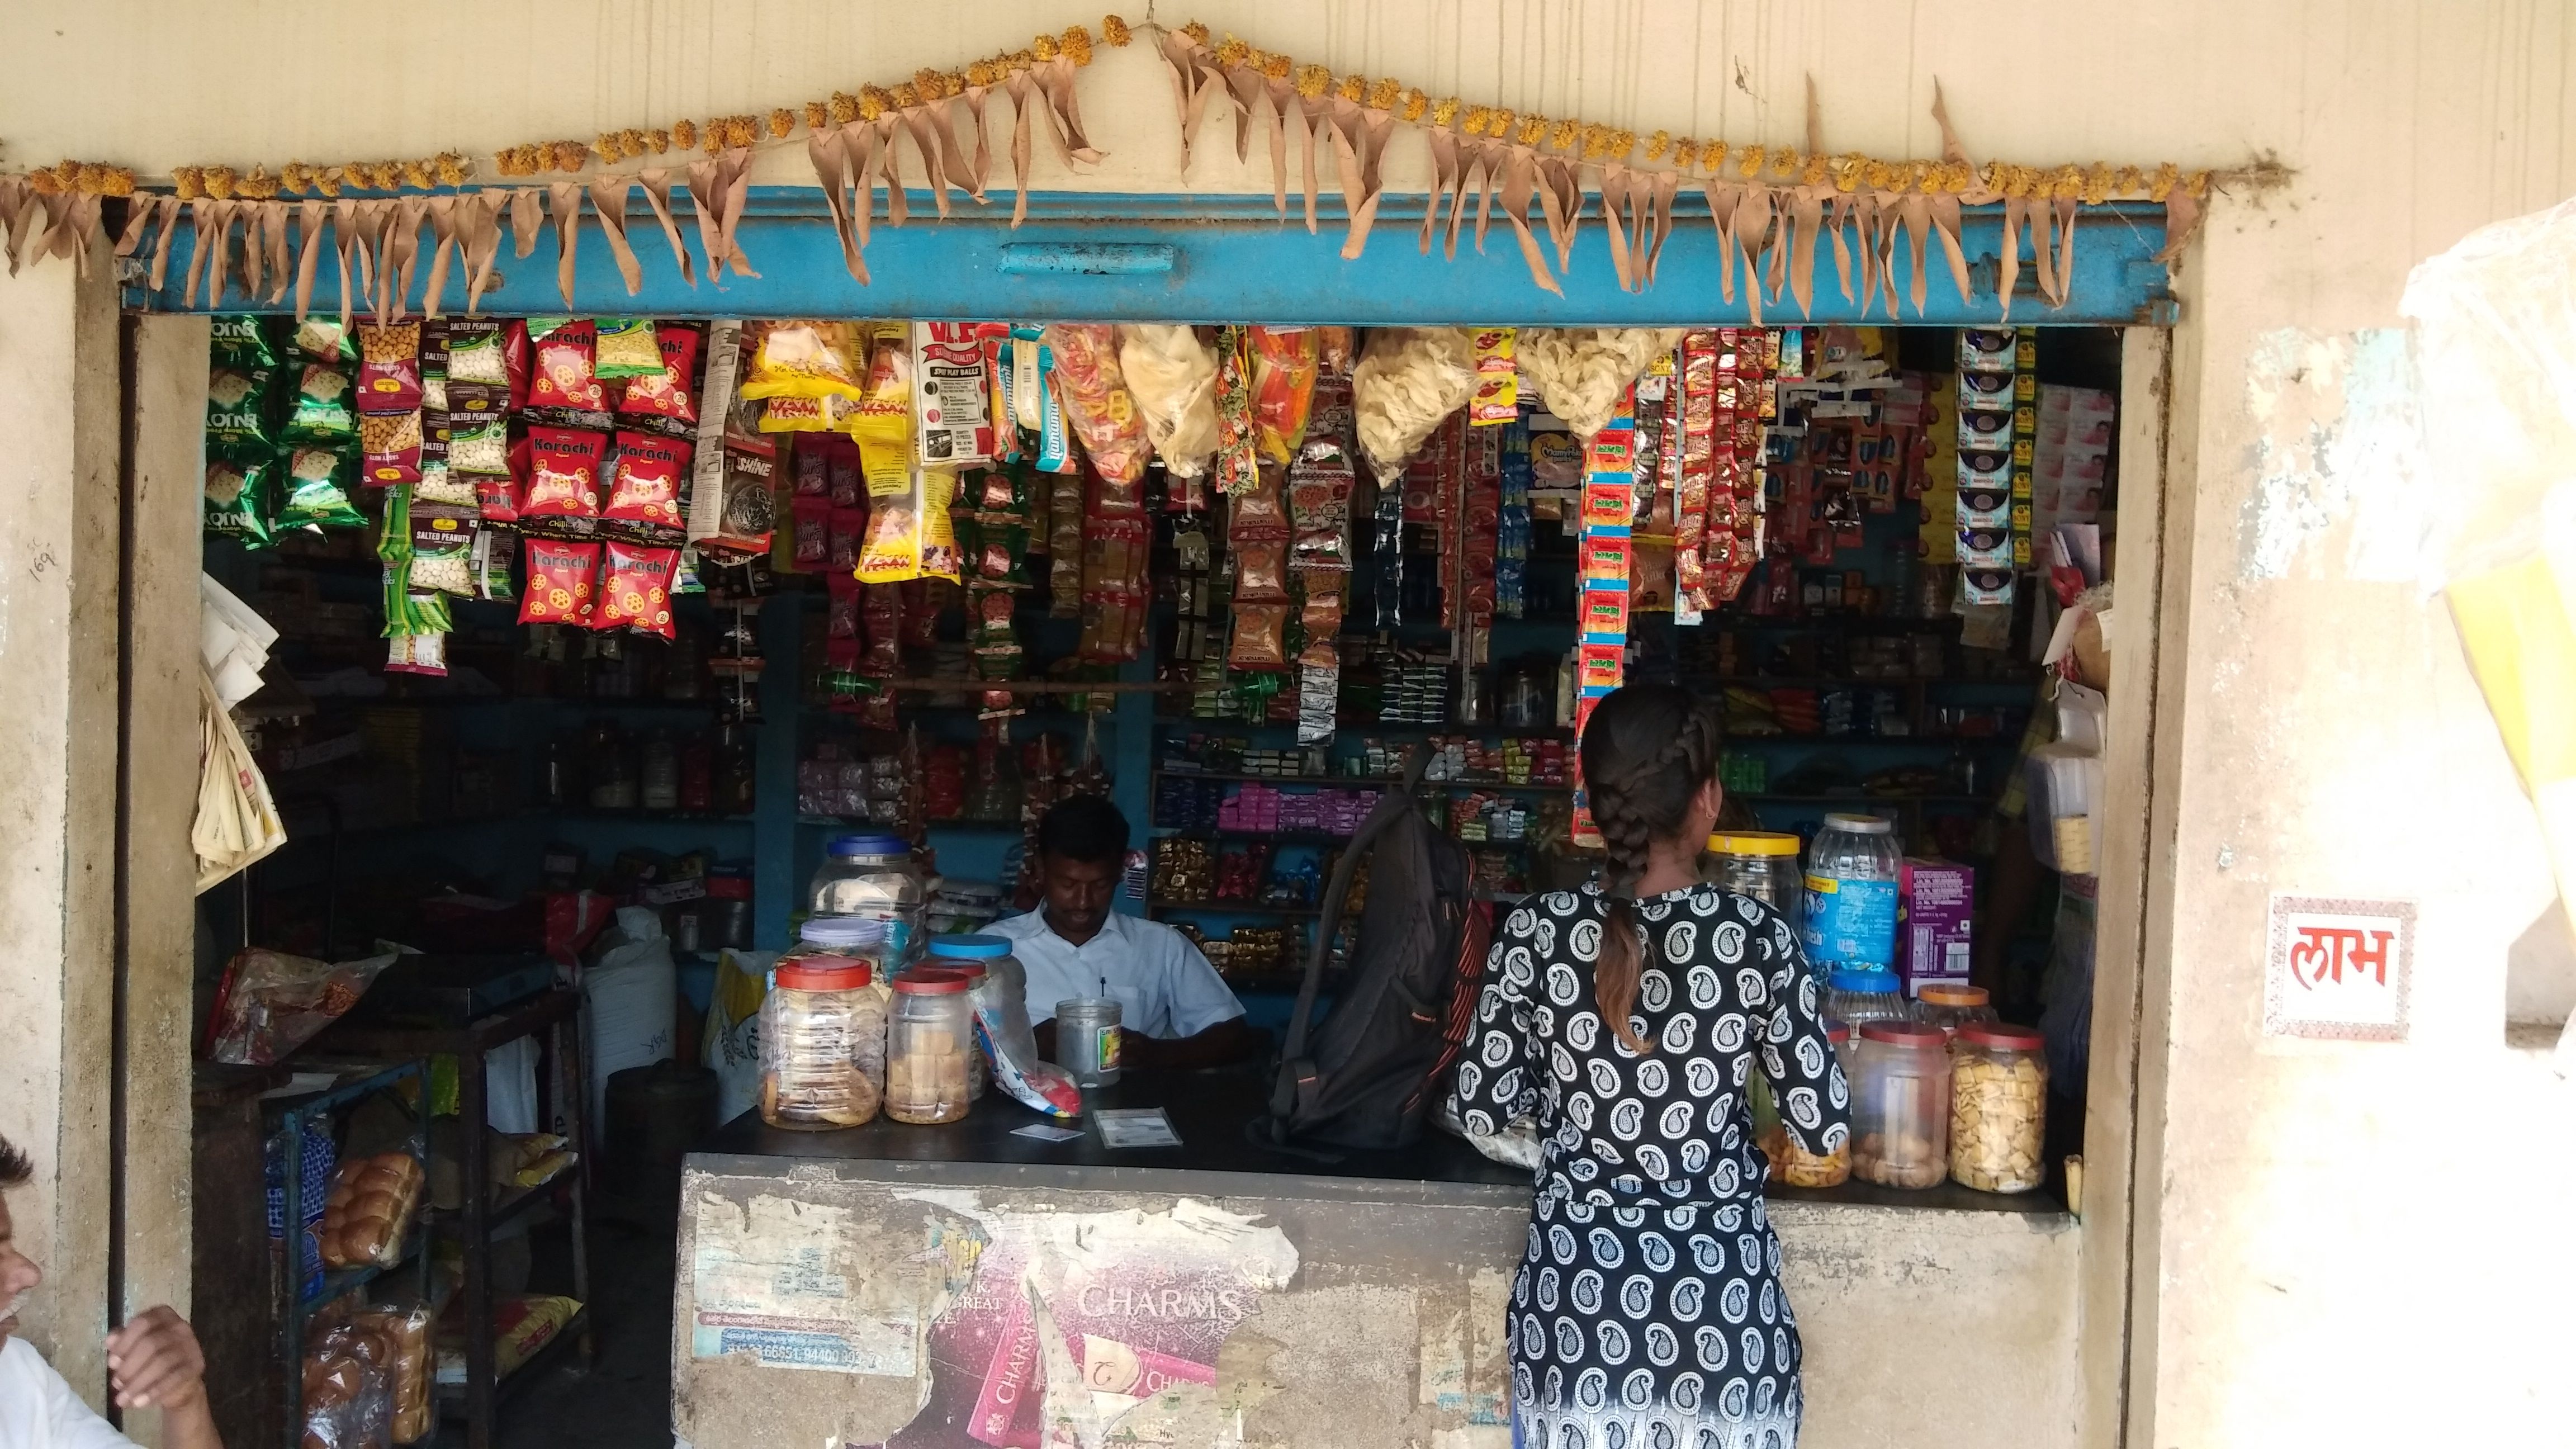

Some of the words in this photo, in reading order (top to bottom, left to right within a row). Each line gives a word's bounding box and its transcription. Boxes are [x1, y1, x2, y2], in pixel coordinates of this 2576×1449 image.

[211, 321, 256, 337] ENJO
[449, 323, 470, 332] SALTED
[471, 323, 499, 332] PEANUTS
[537, 332, 596, 346] arachi
[424, 352, 447, 361] SALTED
[952, 353, 976, 362] QUALITY
[449, 413, 471, 421] SALTED
[471, 413, 499, 421] PEANUTS
[533, 438, 594, 457] Karachi
[619, 442, 678, 462] Karachi
[737, 456, 773, 477] SHINE
[416, 531, 439, 542] SALTED
[441, 532, 471, 544] PEANUTS
[628, 527, 648, 535] Chilli
[2290, 926, 2395, 991] लाभ
[1078, 1285, 1243, 1320] CHARMS
[996, 1312, 1036, 1404] CHARMS
